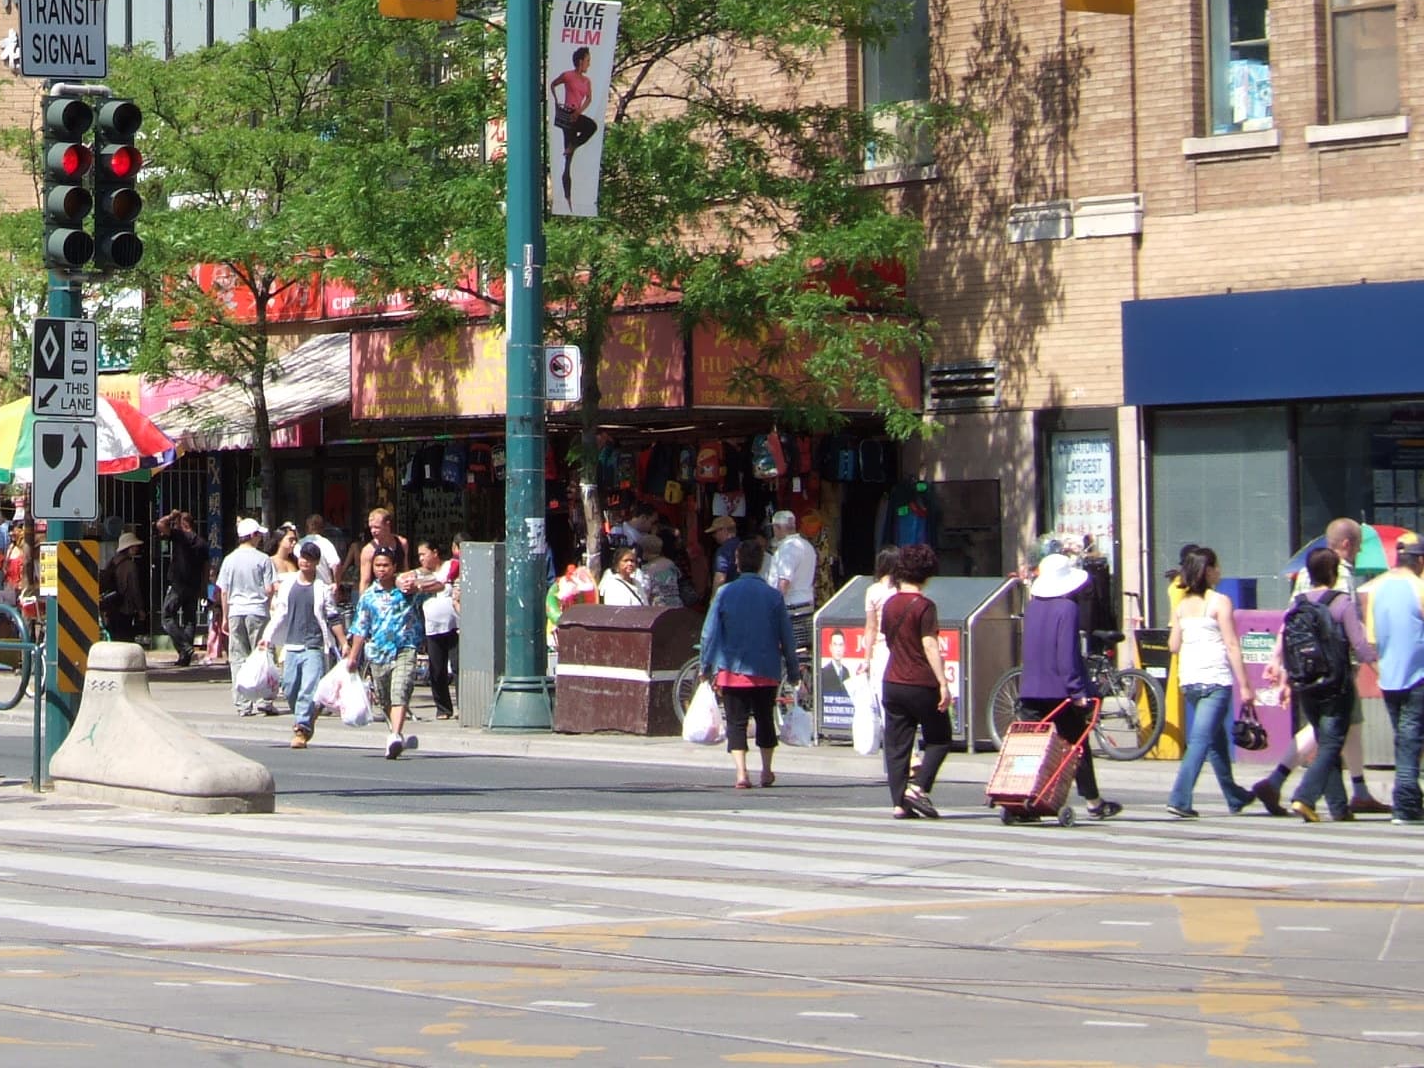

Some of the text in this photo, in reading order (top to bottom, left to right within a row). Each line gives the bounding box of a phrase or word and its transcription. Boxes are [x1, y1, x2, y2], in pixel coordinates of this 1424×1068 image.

[565, 0, 606, 17] LIVE
[563, 15, 603, 31] WITH
[561, 28, 602, 46] FILM
[32, 33, 97, 65] SIGNAL
[64, 382, 90, 395] THIS
[60, 397, 93, 411] LANE
